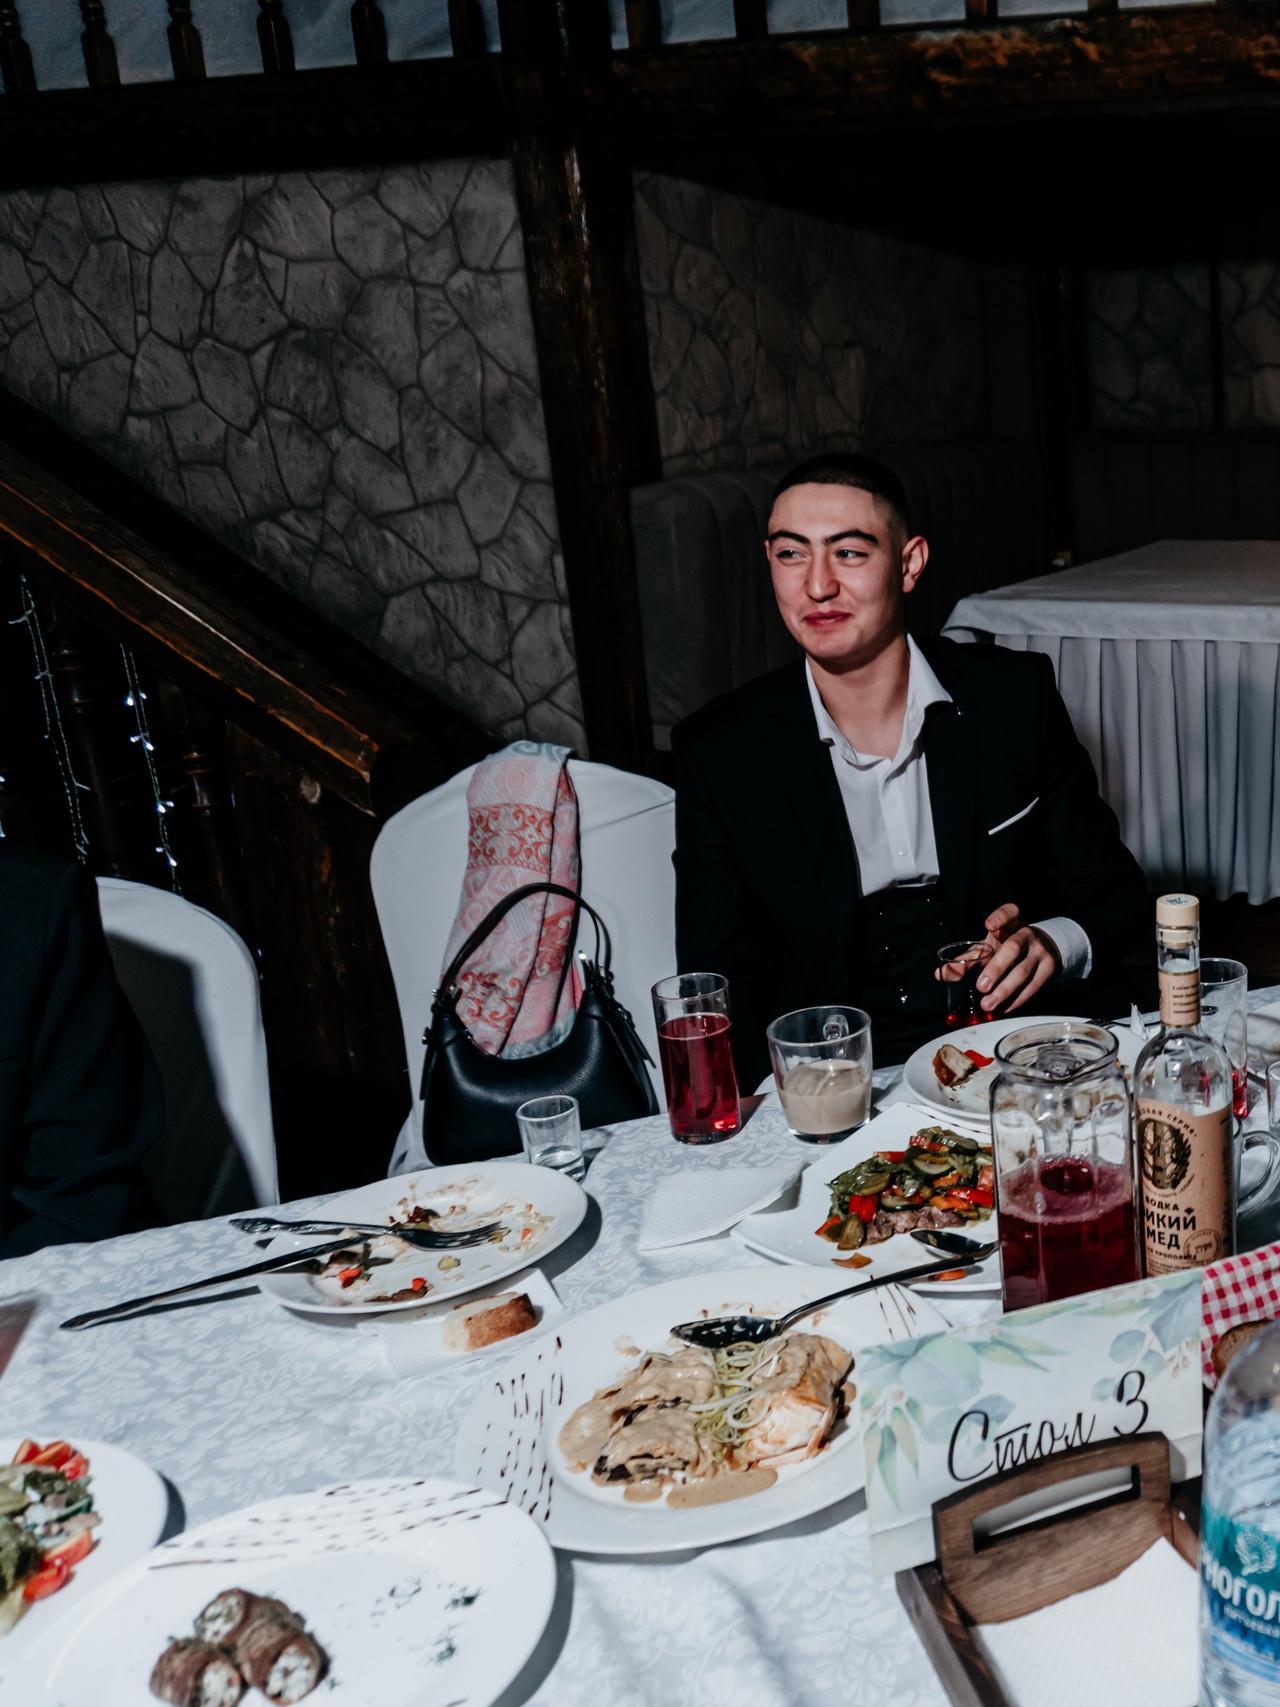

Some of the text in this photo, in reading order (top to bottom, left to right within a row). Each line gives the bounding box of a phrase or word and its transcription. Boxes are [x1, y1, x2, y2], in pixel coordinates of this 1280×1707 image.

[1145, 1195, 1180, 1212] ВОДКА
[1144, 1207, 1197, 1232] ИКИЙ
[1146, 1226, 1181, 1251] МЕД
[947, 1370, 1150, 1482] Стол 3
